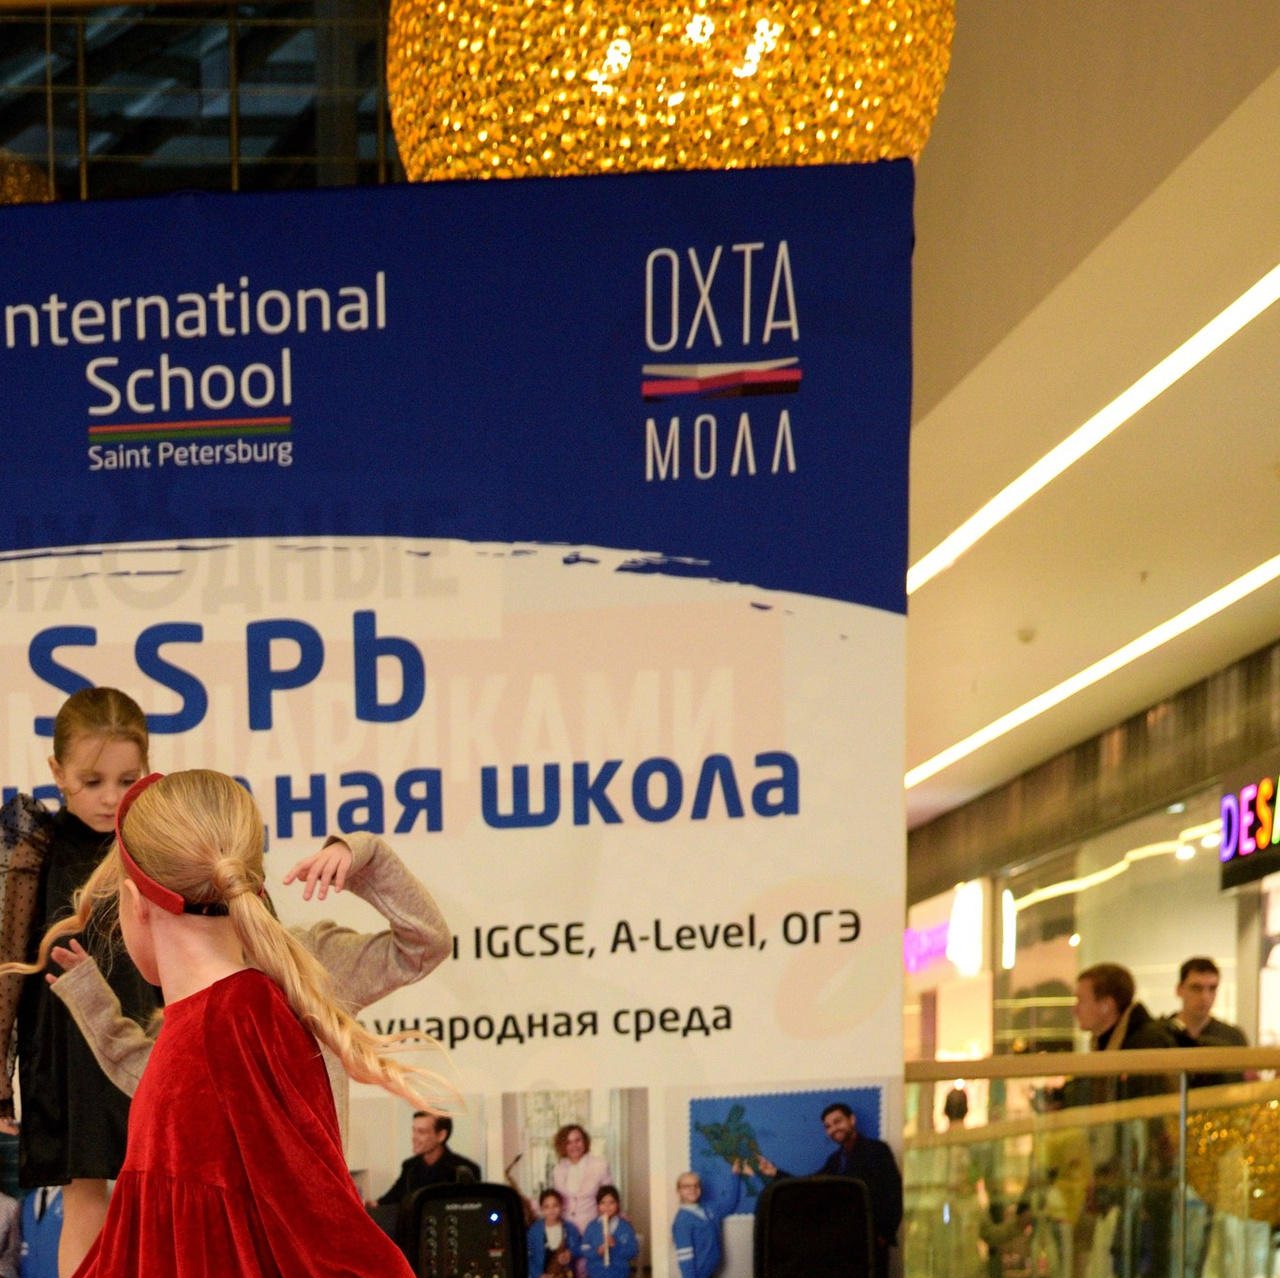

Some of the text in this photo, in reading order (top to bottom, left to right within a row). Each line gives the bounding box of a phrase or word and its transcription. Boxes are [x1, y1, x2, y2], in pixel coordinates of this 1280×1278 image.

[644, 240, 802, 353] ОХТА
[85, 348, 294, 418] School
[88, 439, 294, 473] Saint Petersburg
[644, 409, 798, 483] МОЛЛ
[480, 751, 801, 830] школа
[474, 923, 596, 961] IGCSE,
[610, 914, 768, 955] A-Level,
[782, 910, 863, 947] ОГЭ
[613, 1005, 734, 1044] среда
